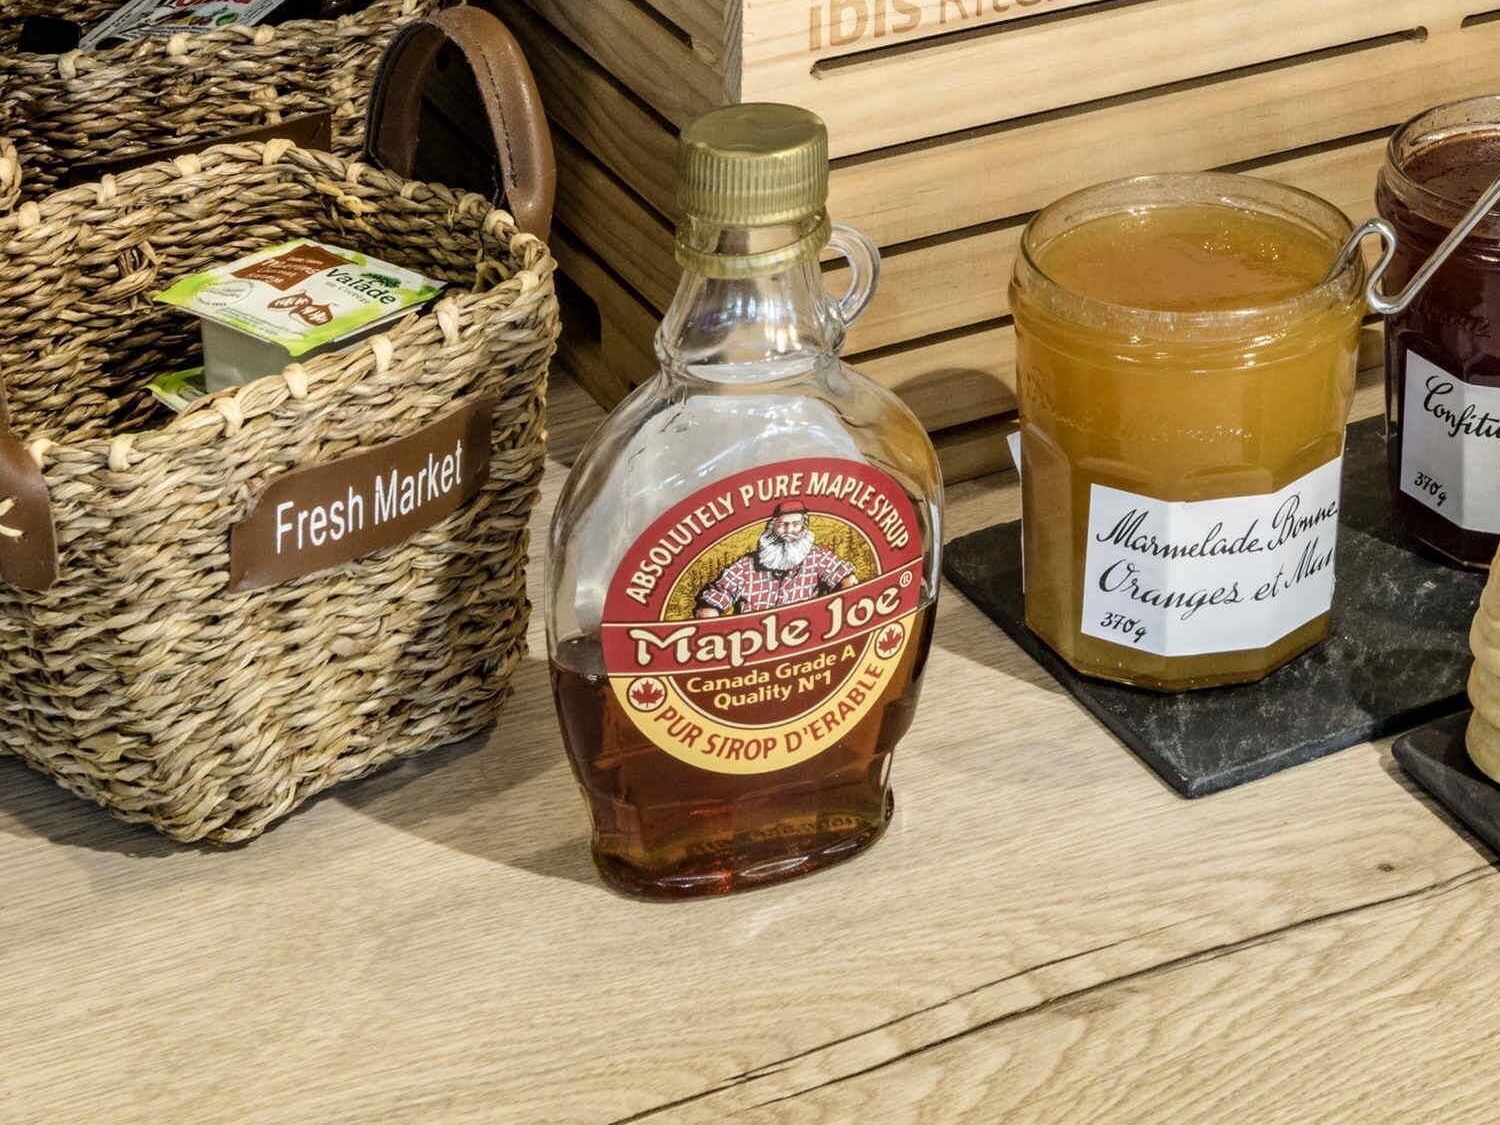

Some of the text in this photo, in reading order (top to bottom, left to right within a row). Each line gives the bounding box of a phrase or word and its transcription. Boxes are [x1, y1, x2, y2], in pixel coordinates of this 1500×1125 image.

[326, 268, 396, 305] Valade
[275, 438, 463, 555] Fresh Market
[1096, 490, 1339, 560] Marmelade Bonne
[626, 471, 910, 605] ABSOLUTELY PURE MAPLE SYRUP
[1099, 558, 1244, 622] Oranges
[1253, 565, 1285, 602] et
[629, 614, 811, 667] Maple
[686, 643, 858, 693] Canada Grade A
[654, 661, 885, 762] PUR SIROP D'ERABLE
[713, 682, 793, 711] Quality
